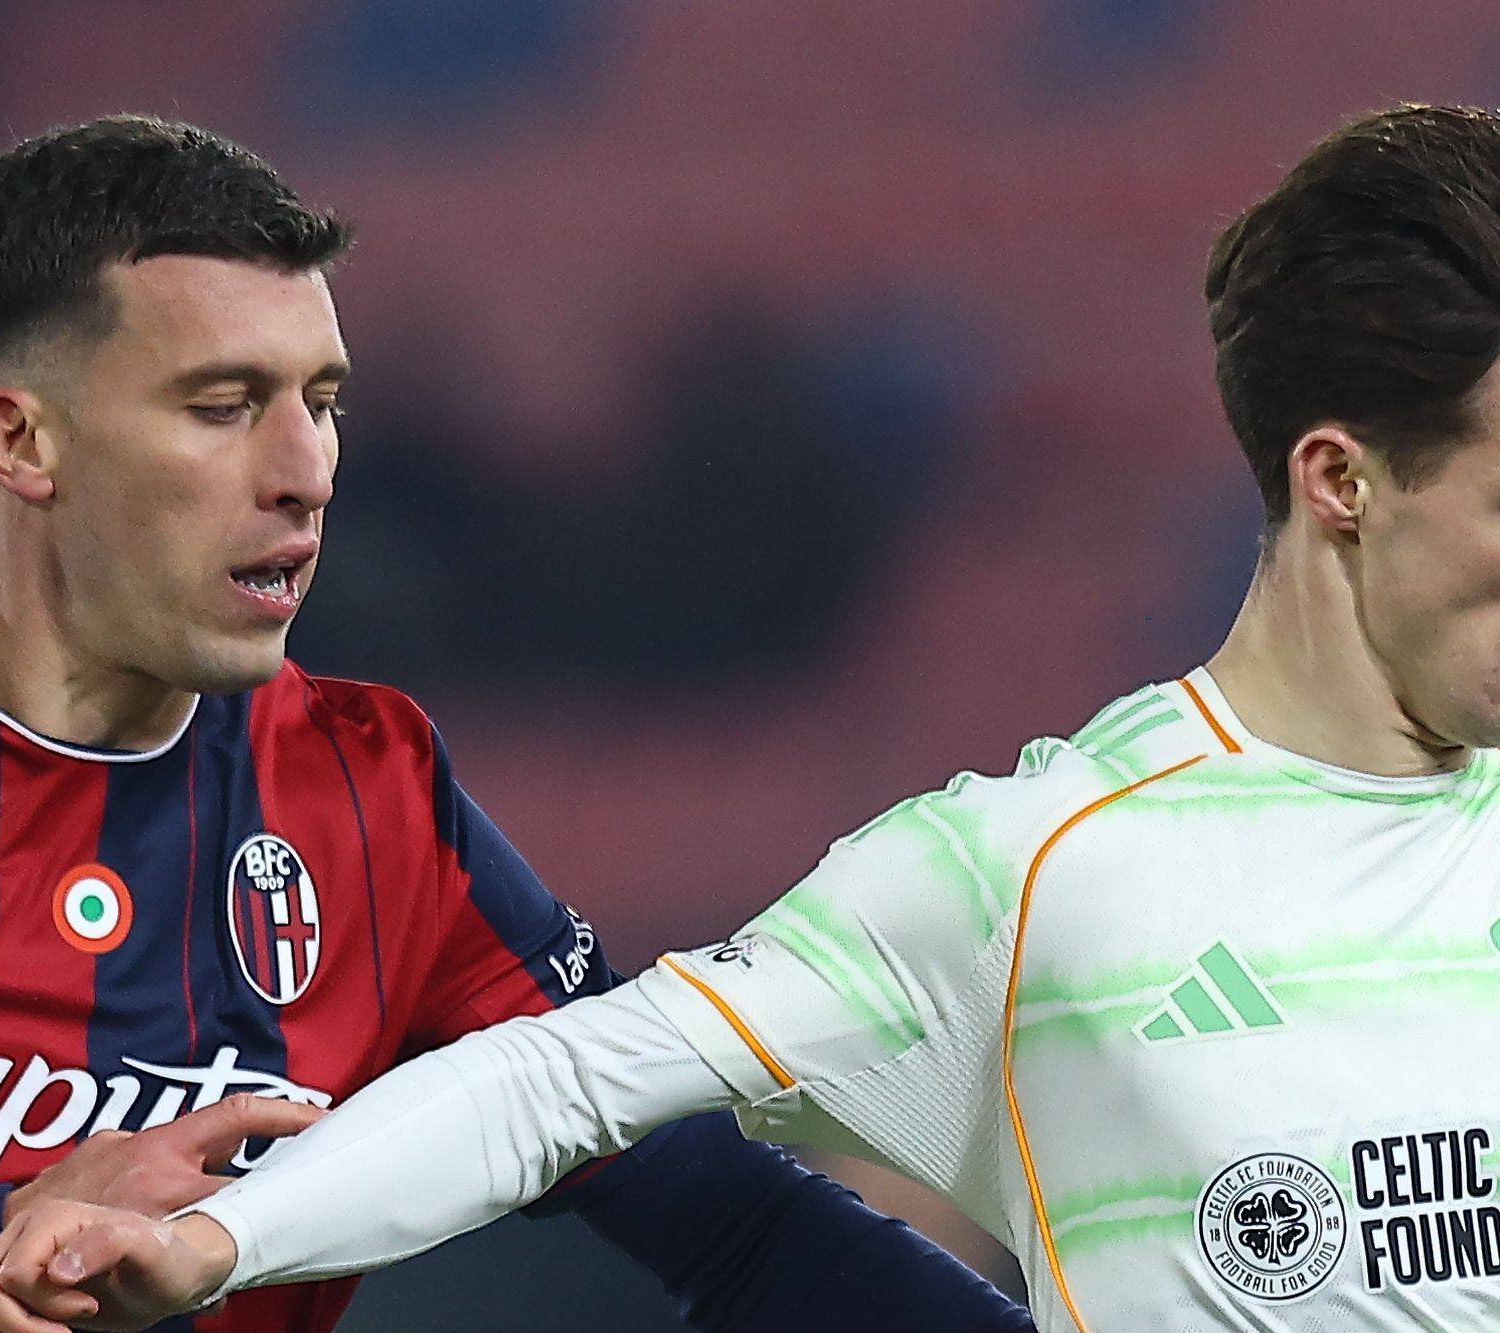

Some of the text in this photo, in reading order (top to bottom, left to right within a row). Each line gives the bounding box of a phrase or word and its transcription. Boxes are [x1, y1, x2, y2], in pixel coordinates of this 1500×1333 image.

[245, 841, 291, 877] BFC
[254, 876, 285, 891] 1909
[1351, 1127, 1493, 1210] CELTIC
[1207, 1160, 1335, 1220] CELTIC FC FOUNDATION
[1209, 1228, 1221, 1242] 18
[1326, 1216, 1340, 1231] 88
[1215, 1242, 1337, 1294] FOOTBALL FOR GOOD
